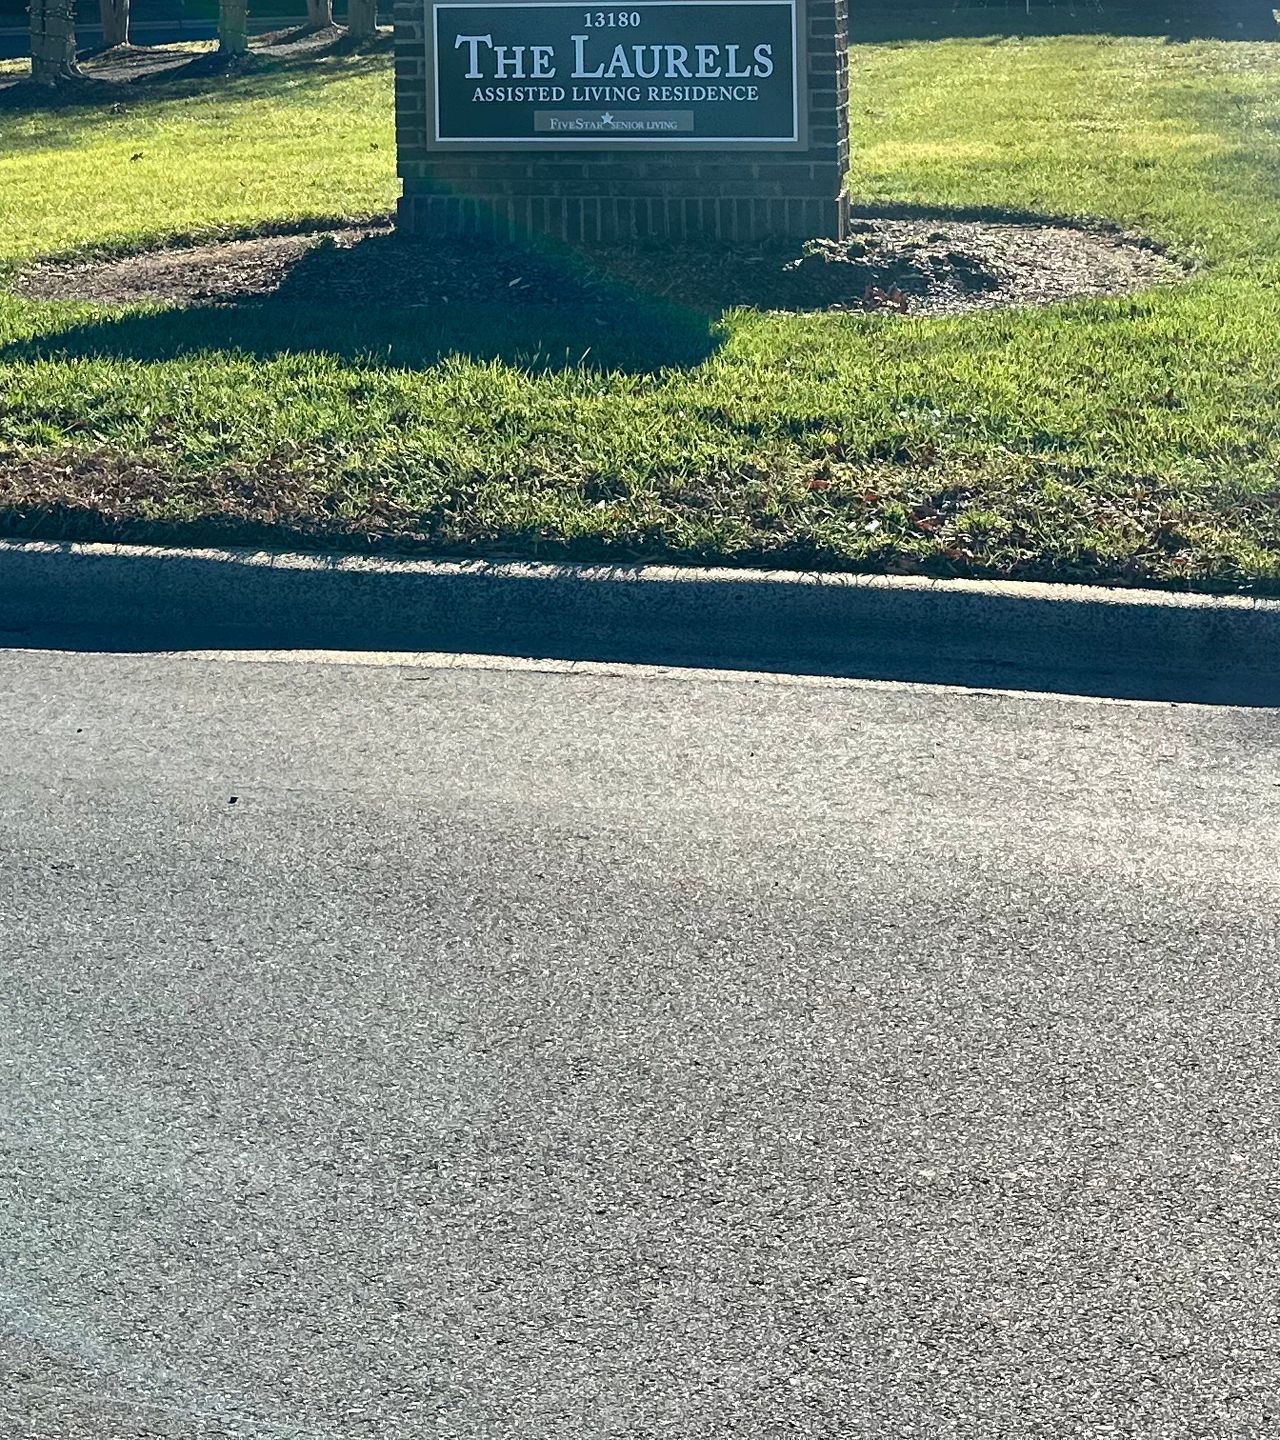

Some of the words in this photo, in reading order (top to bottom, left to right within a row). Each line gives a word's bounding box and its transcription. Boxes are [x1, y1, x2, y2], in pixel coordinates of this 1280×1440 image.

[583, 12, 641, 27] 13180
[454, 33, 556, 79] THE
[570, 34, 775, 79] LAURELS
[472, 87, 565, 102] ASSISTED
[572, 86, 641, 102] LIVING
[647, 85, 759, 102] RESIDENCE
[646, 120, 678, 130] LIVING
